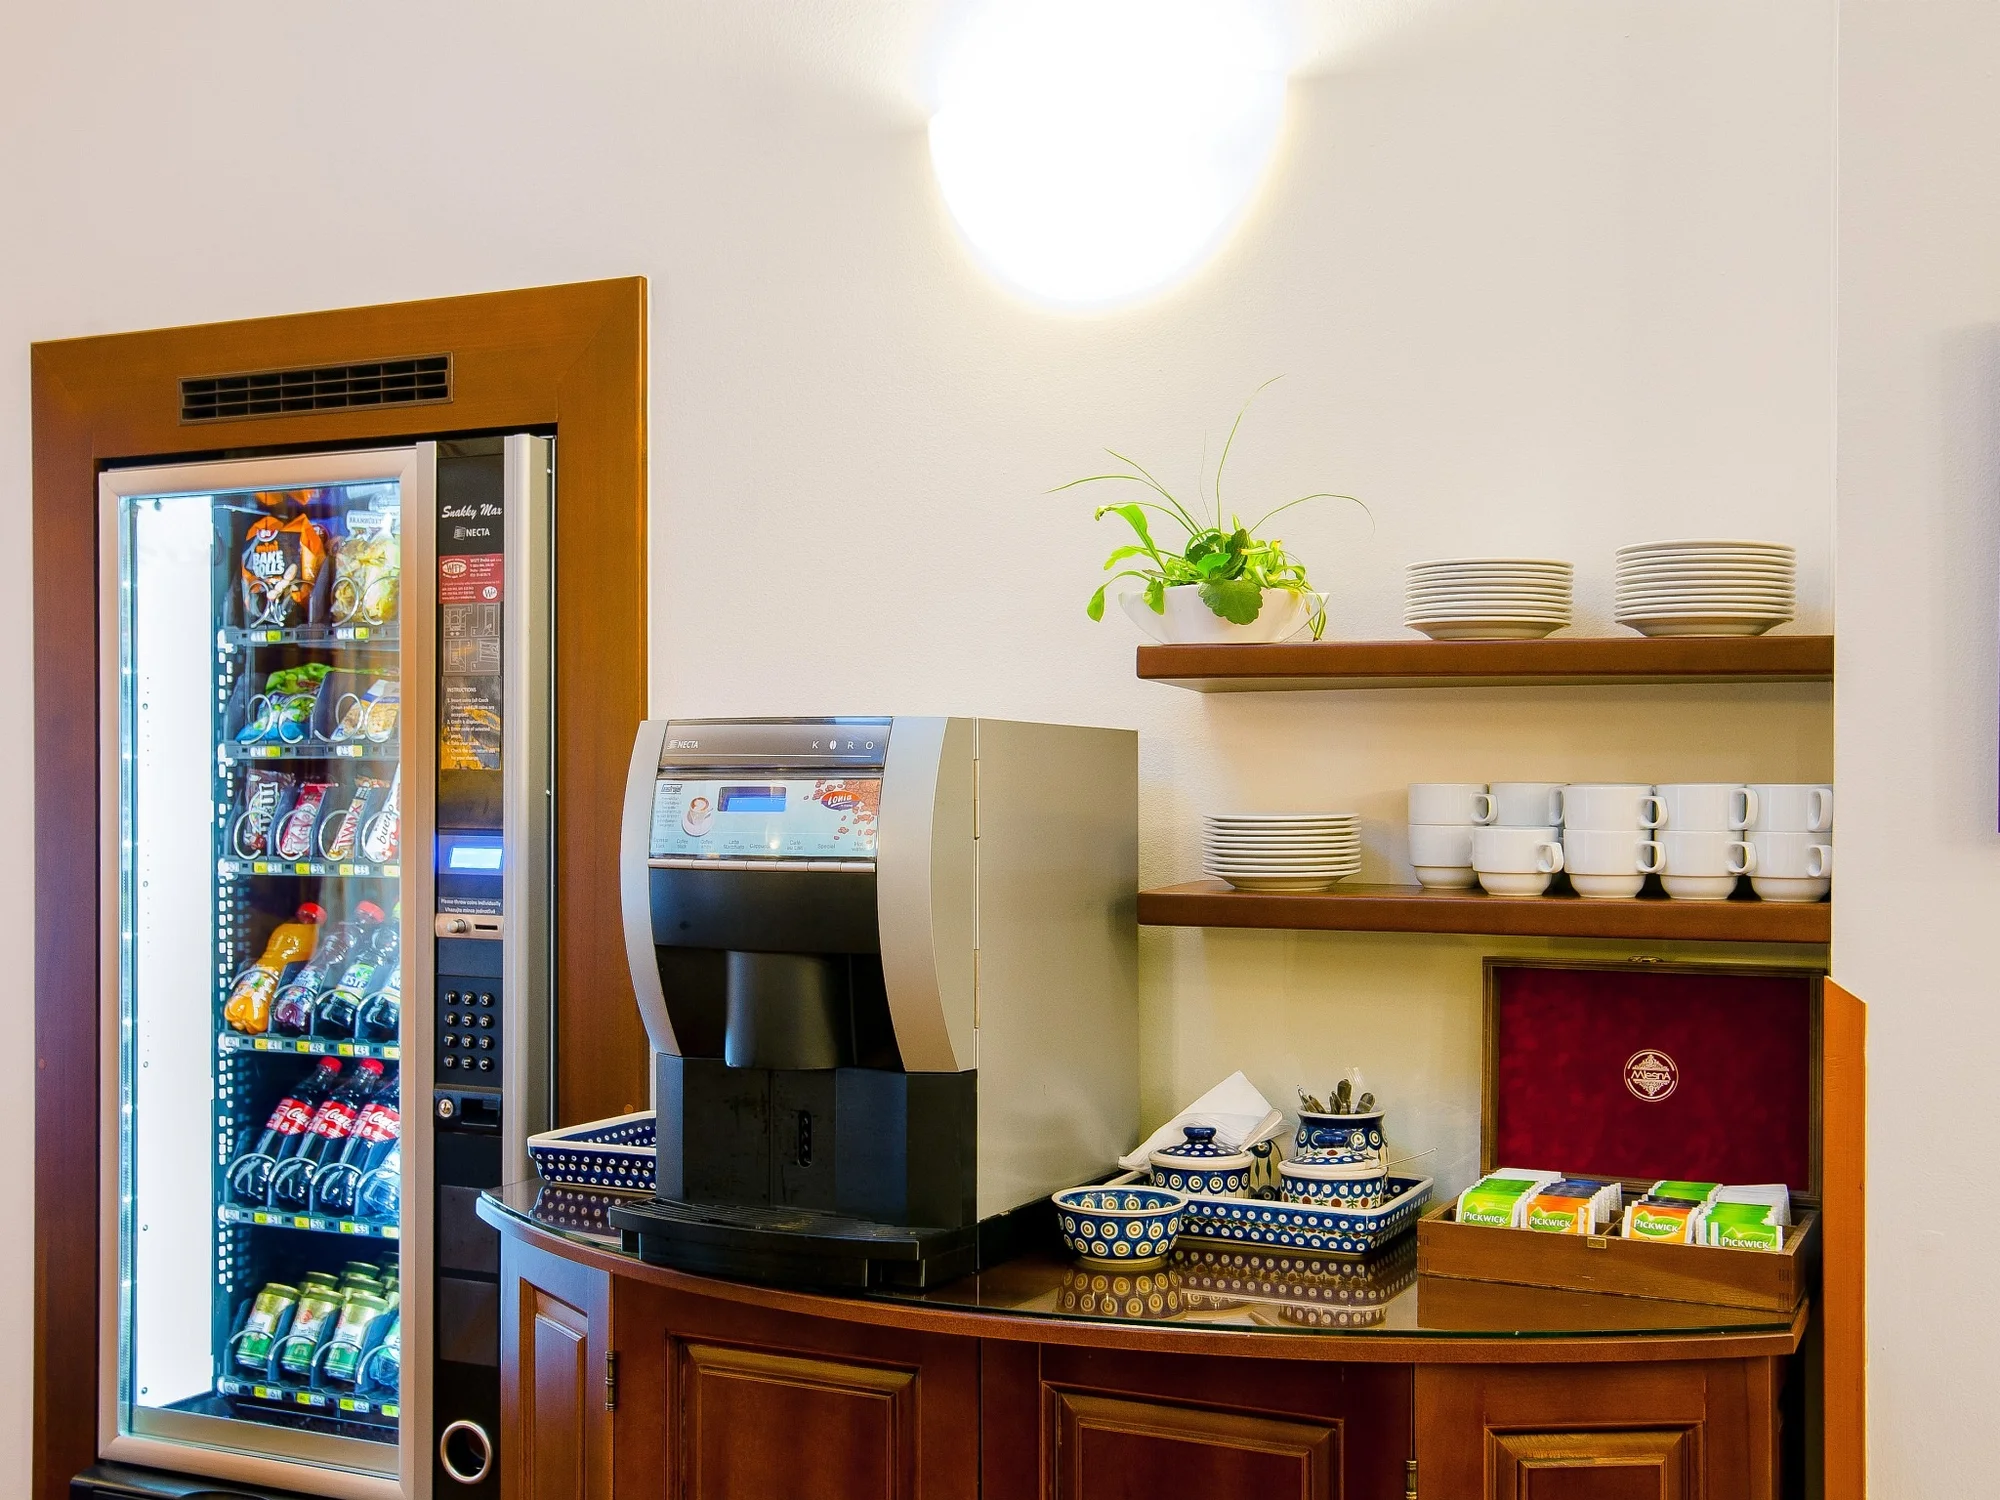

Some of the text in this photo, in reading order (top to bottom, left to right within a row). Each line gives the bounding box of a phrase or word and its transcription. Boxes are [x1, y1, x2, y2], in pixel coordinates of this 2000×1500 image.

[442, 504, 502, 520] Snakky Max
[466, 528, 490, 537] NECTA
[376, 804, 395, 844] bueno
[1464, 1211, 1506, 1224] PICKWICK
[1529, 1216, 1571, 1228] PICKWICK
[1634, 1218, 1679, 1232] PICKWICK
[1722, 1237, 1770, 1249] PICKWICK
